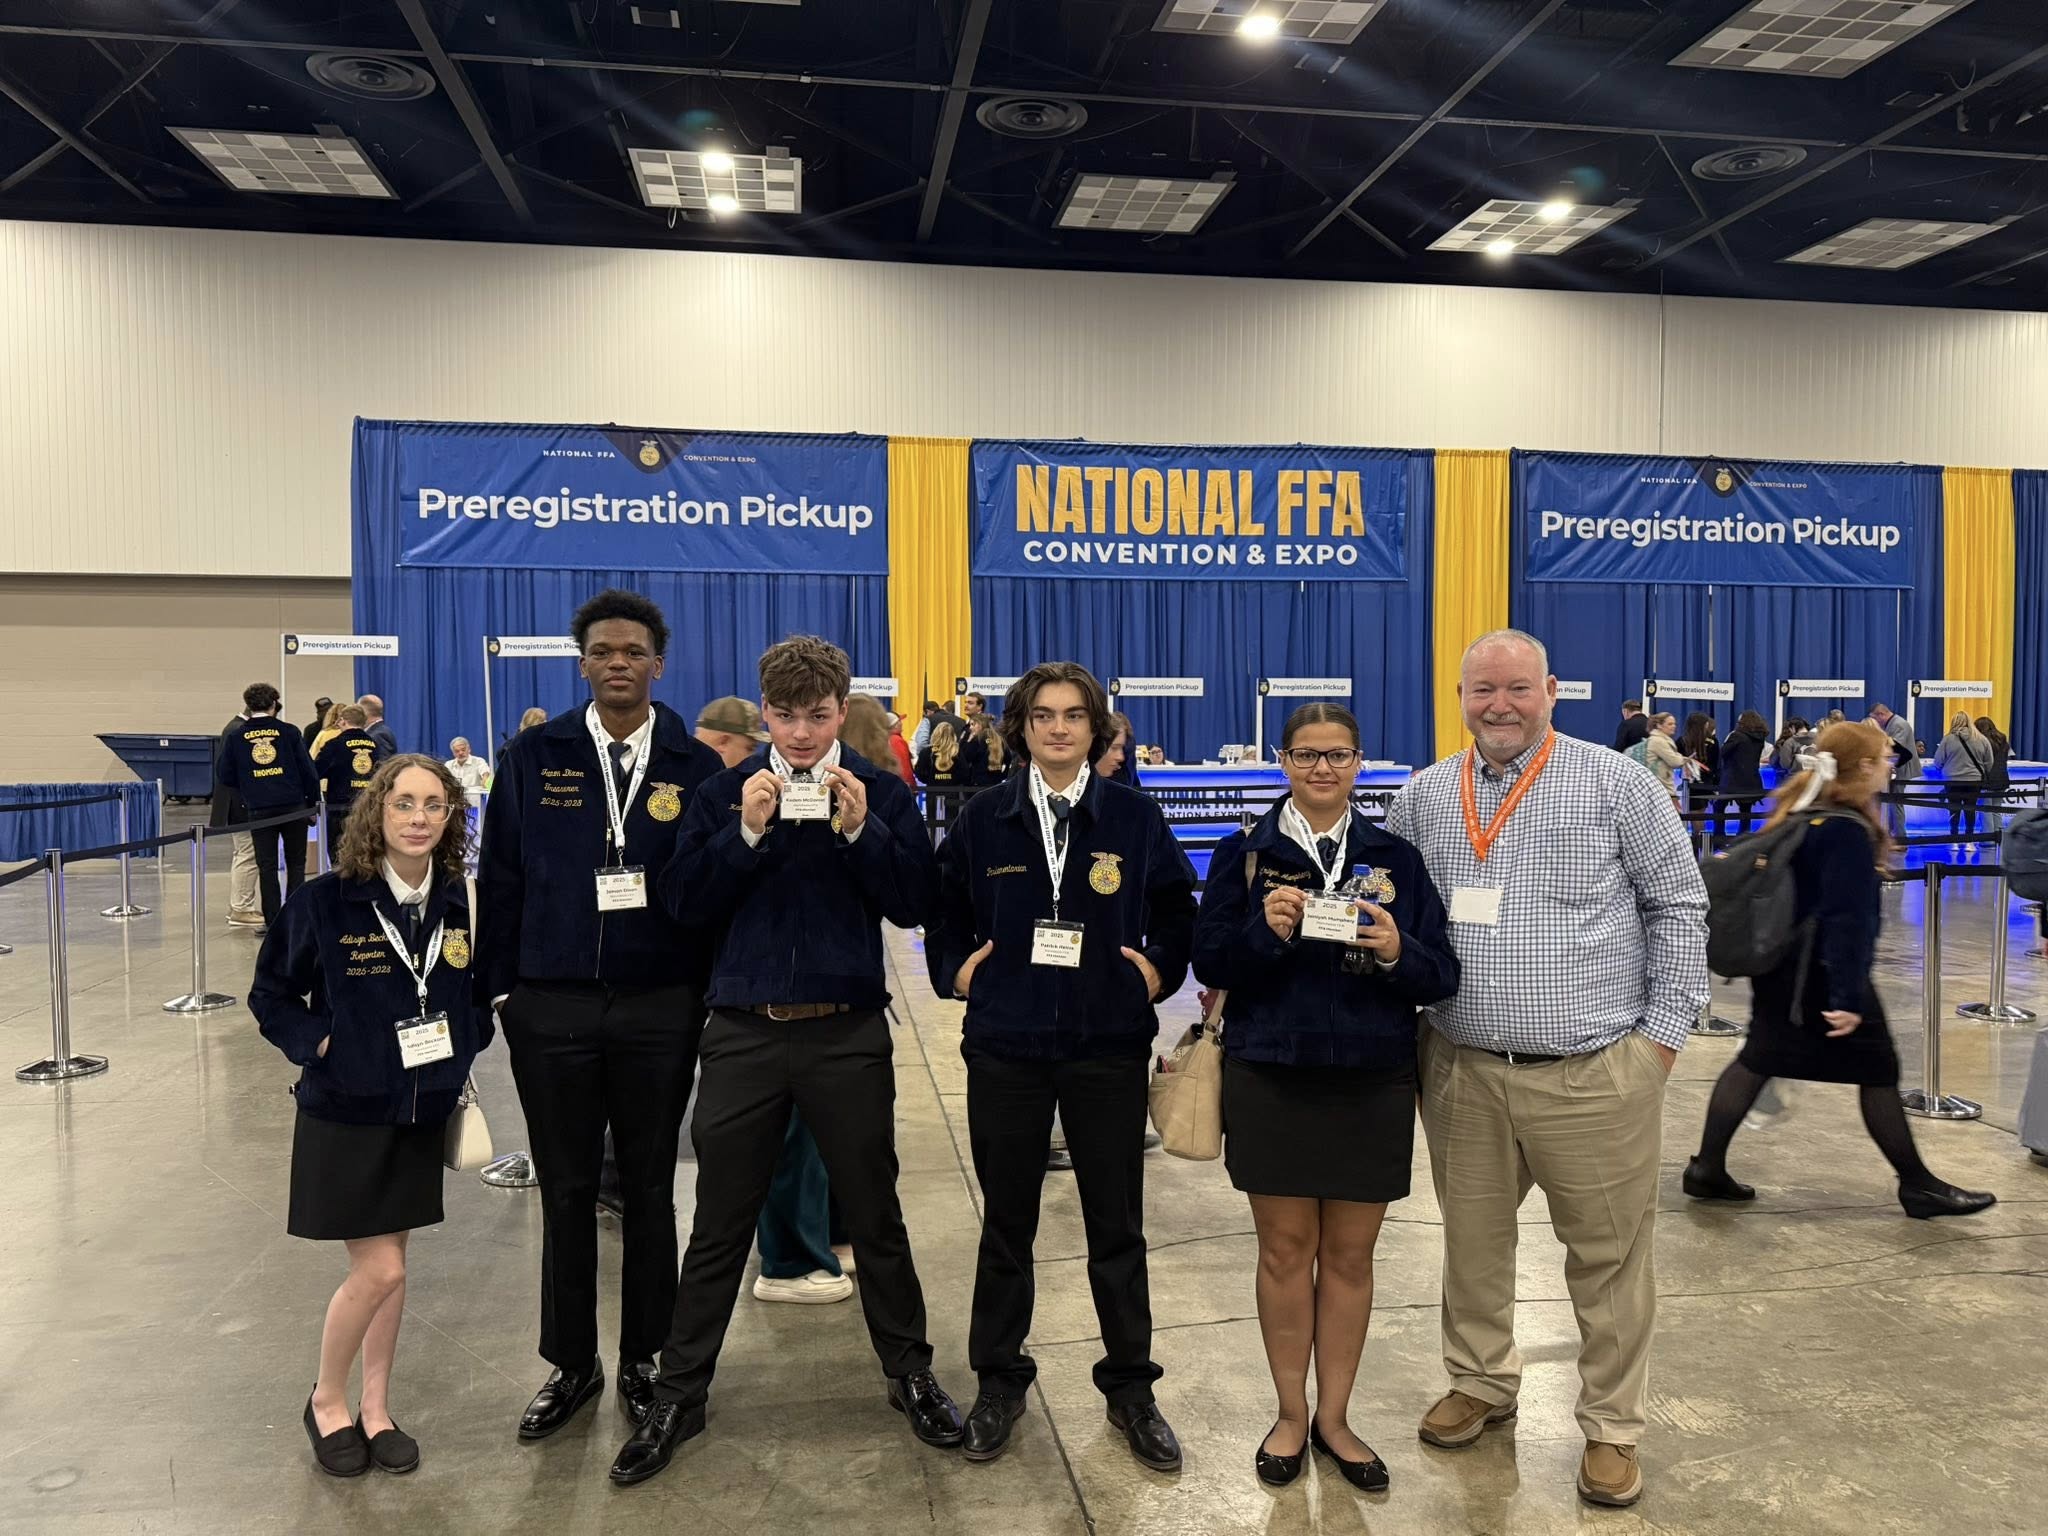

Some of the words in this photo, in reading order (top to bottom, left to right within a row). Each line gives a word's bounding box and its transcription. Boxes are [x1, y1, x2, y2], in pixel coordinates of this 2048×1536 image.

[543, 450, 593, 458] NATIONAL
[683, 454, 730, 462] CONVENTION
[1749, 480, 1785, 488] CONVENTION
[1016, 464, 1265, 536] NATIONAL
[1277, 470, 1366, 537] FFA
[418, 486, 730, 530] Preregistration
[740, 493, 874, 536] Pickup
[1541, 510, 1786, 548] Preregistration
[1793, 516, 1900, 553] Pickup
[1023, 540, 1237, 564] CONVENTION
[1246, 543, 1267, 565] &
[1275, 543, 1358, 566] EXPO
[302, 640, 362, 651] Preregistration
[363, 641, 392, 651] Pickup
[504, 642, 562, 651] Preregistration
[867, 682, 893, 692] Pickup
[972, 682, 1010, 693] Preregistra
[1125, 682, 1174, 692] Preregistration
[1175, 682, 1200, 692] Pickup
[1272, 682, 1322, 692] Preregistration
[1323, 682, 1347, 692] Pickup
[1563, 686, 1587, 695] Pickup
[1659, 684, 1706, 694] Preregistration
[1706, 687, 1730, 697] Pickup
[1792, 683, 1838, 693] Preregistration
[1838, 684, 1861, 694] Pickup
[1923, 684, 1967, 694] Preregistration
[1967, 684, 1989, 694] Pickup
[244, 729, 280, 739] GEORGIA
[346, 739, 376, 748] GEORGIA
[253, 767, 283, 777] THOMSON
[351, 780, 369, 788] THOMS
[350, 950, 386, 963] Reporter
